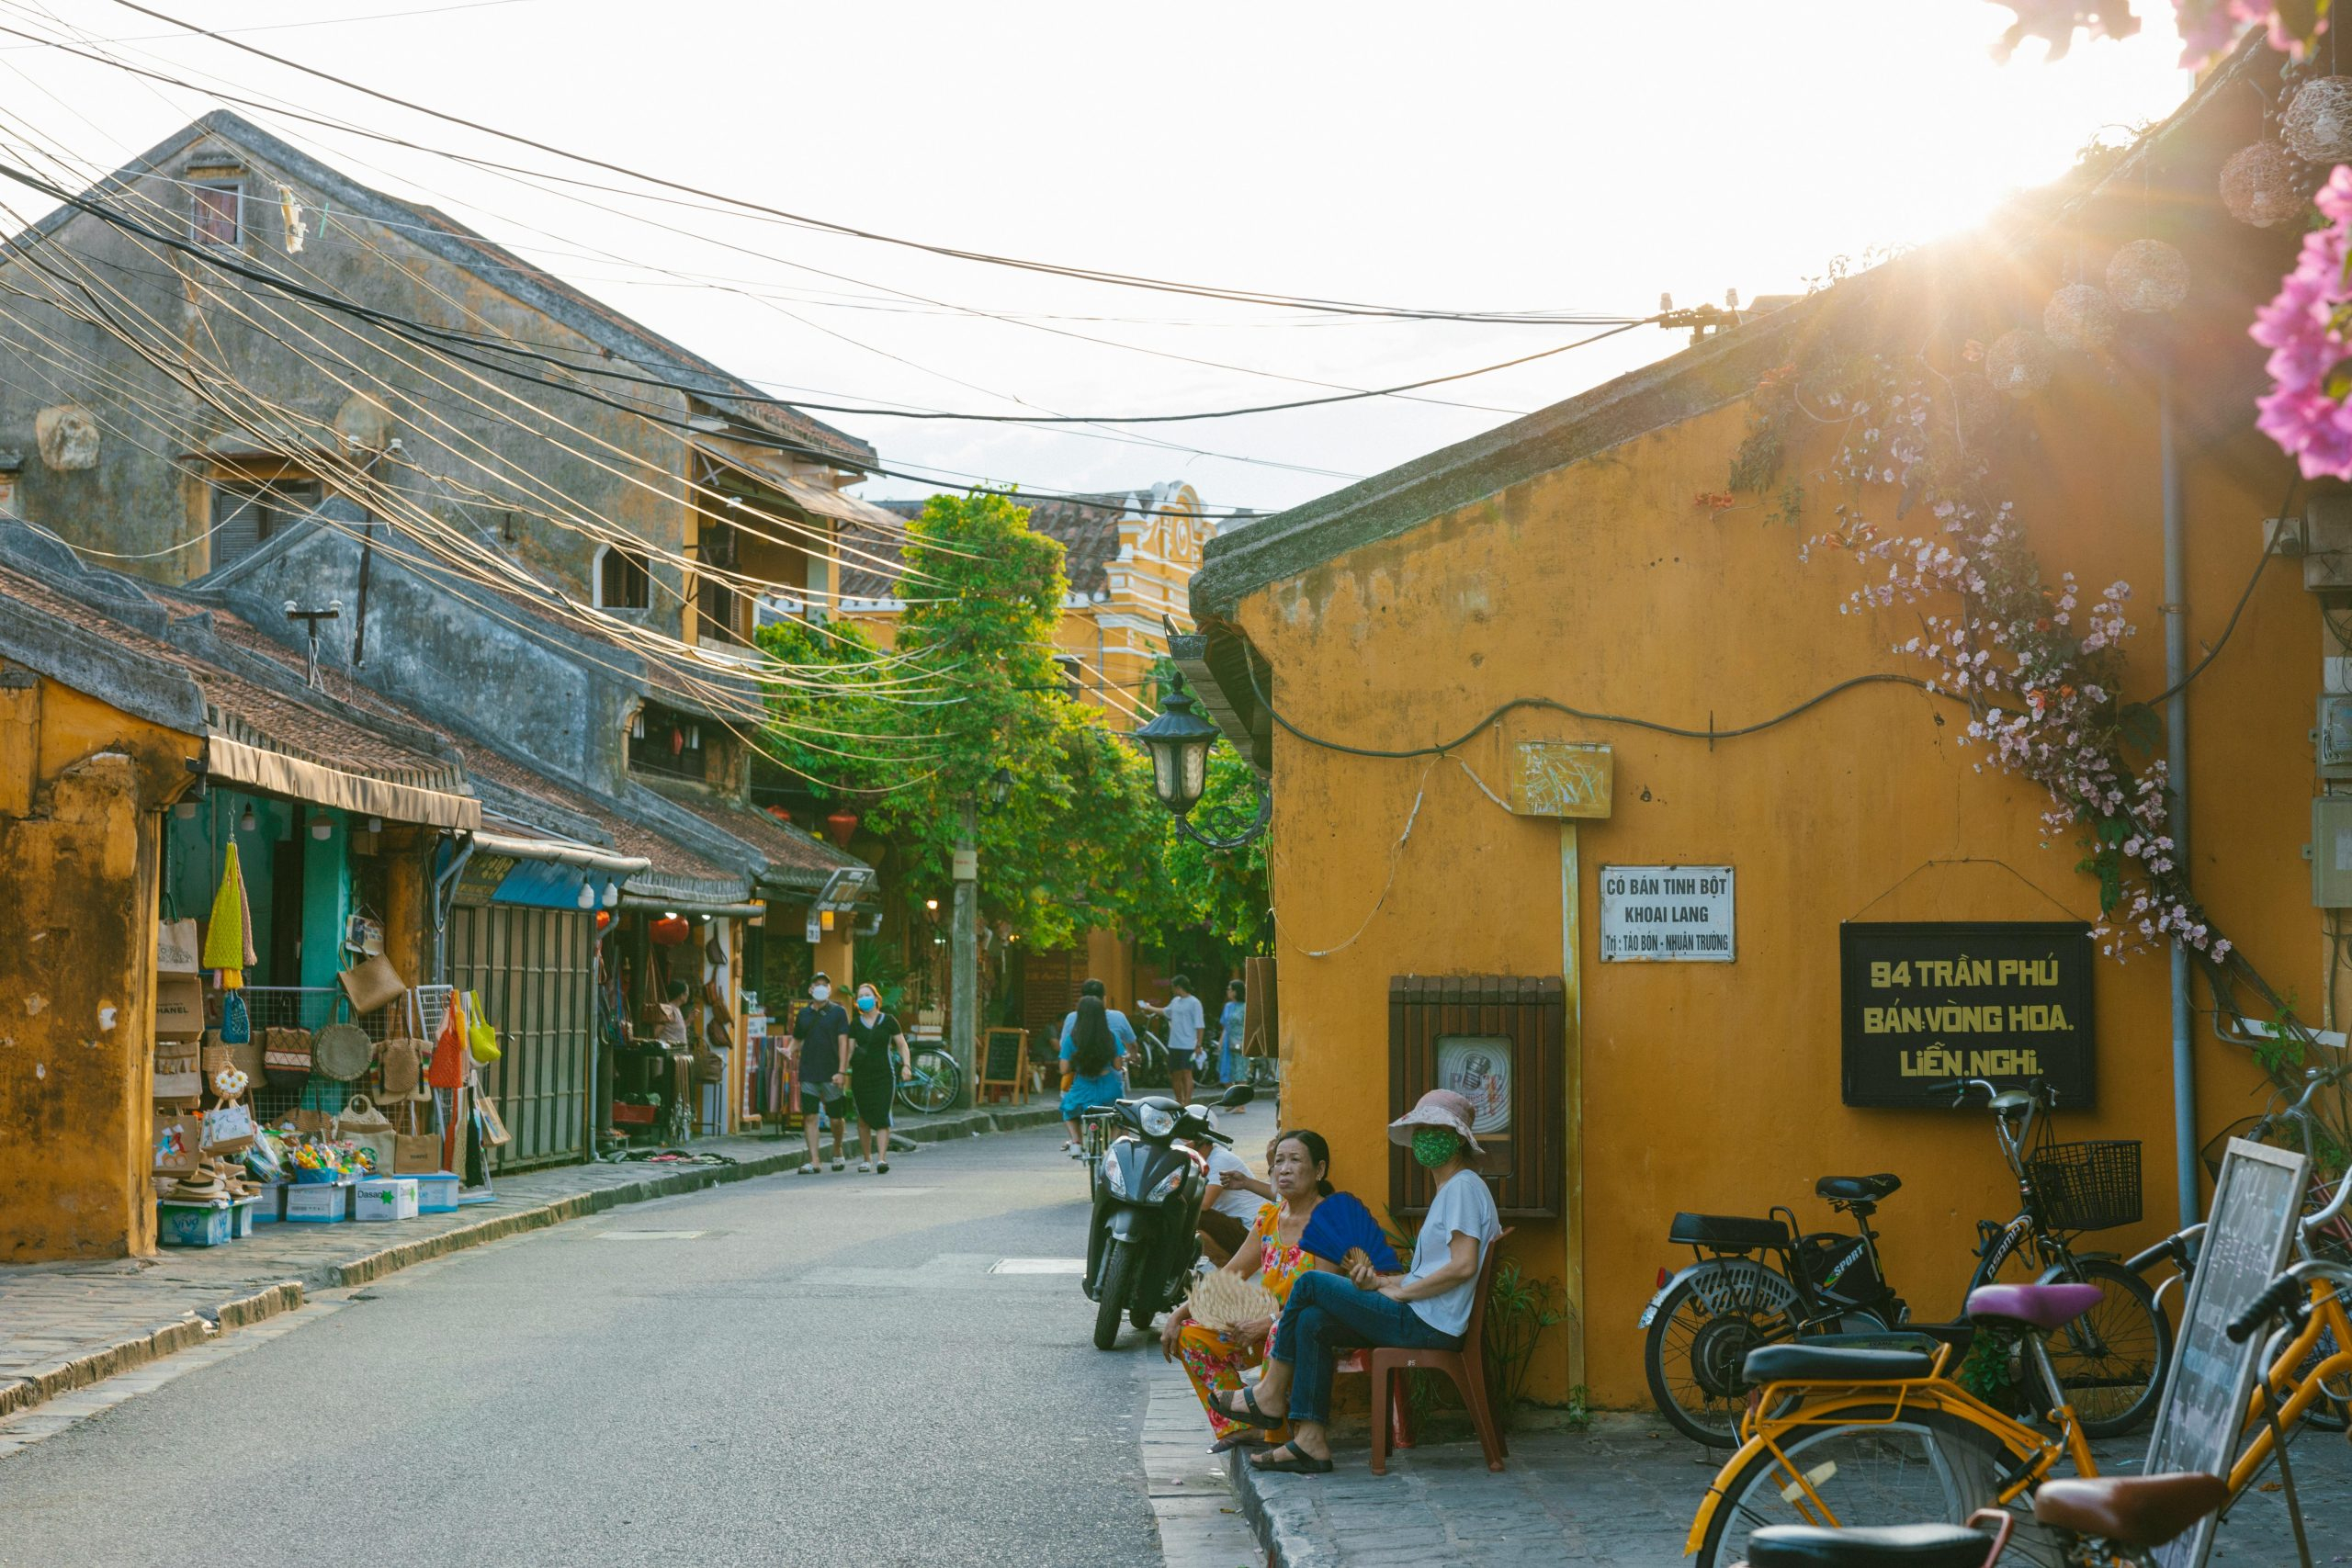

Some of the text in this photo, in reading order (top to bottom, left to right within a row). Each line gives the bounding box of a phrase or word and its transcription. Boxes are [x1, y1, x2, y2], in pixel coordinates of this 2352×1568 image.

[1606, 874, 1727, 898] CÓ BÁN TINH BỘT
[1624, 907, 1709, 923] KHOAI LANG
[1641, 931, 1658, 952] BÓN
[1871, 952, 2059, 987] 94 TRẦN PHÚ
[157, 1006, 189, 1015] HANEL
[1925, 998, 2003, 1032] VÒNG
[357, 1190, 384, 1199] Dasan
[1833, 1244, 1864, 1277] SPORT
